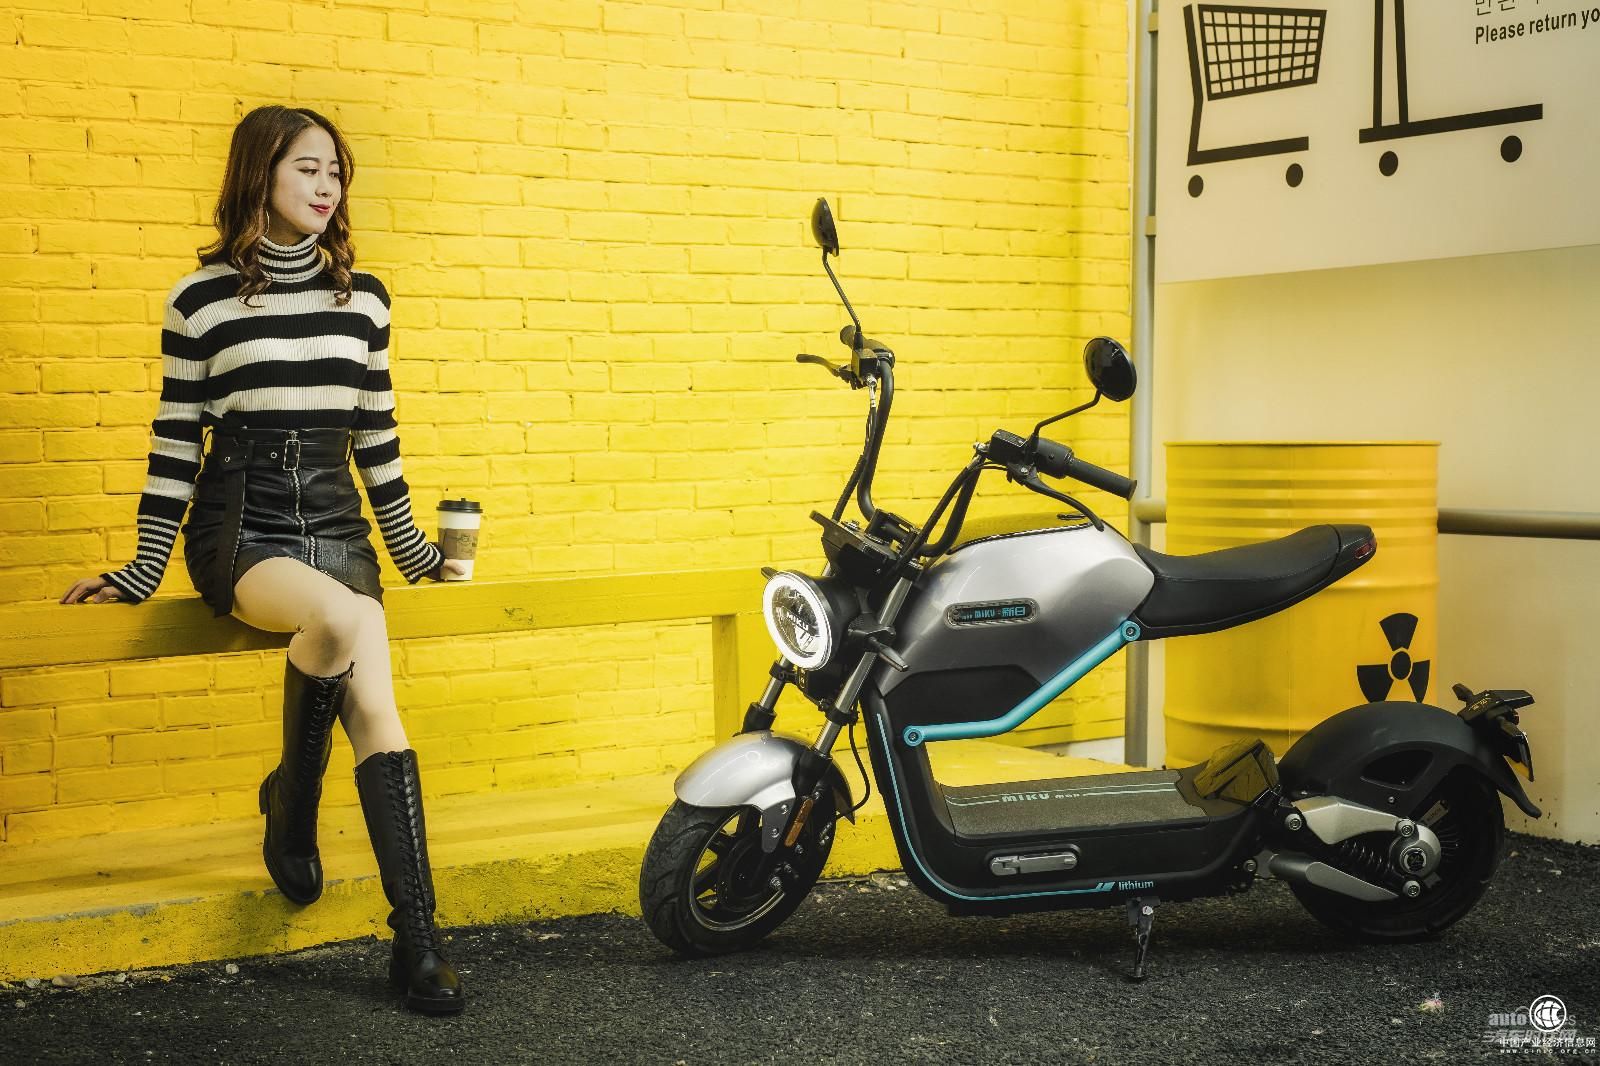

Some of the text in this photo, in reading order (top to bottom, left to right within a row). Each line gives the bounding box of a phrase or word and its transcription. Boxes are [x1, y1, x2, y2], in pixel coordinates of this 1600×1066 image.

[1475, 23, 1525, 44] Please
[1529, 13, 1577, 34] return
[1118, 880, 1154, 890] lithium
